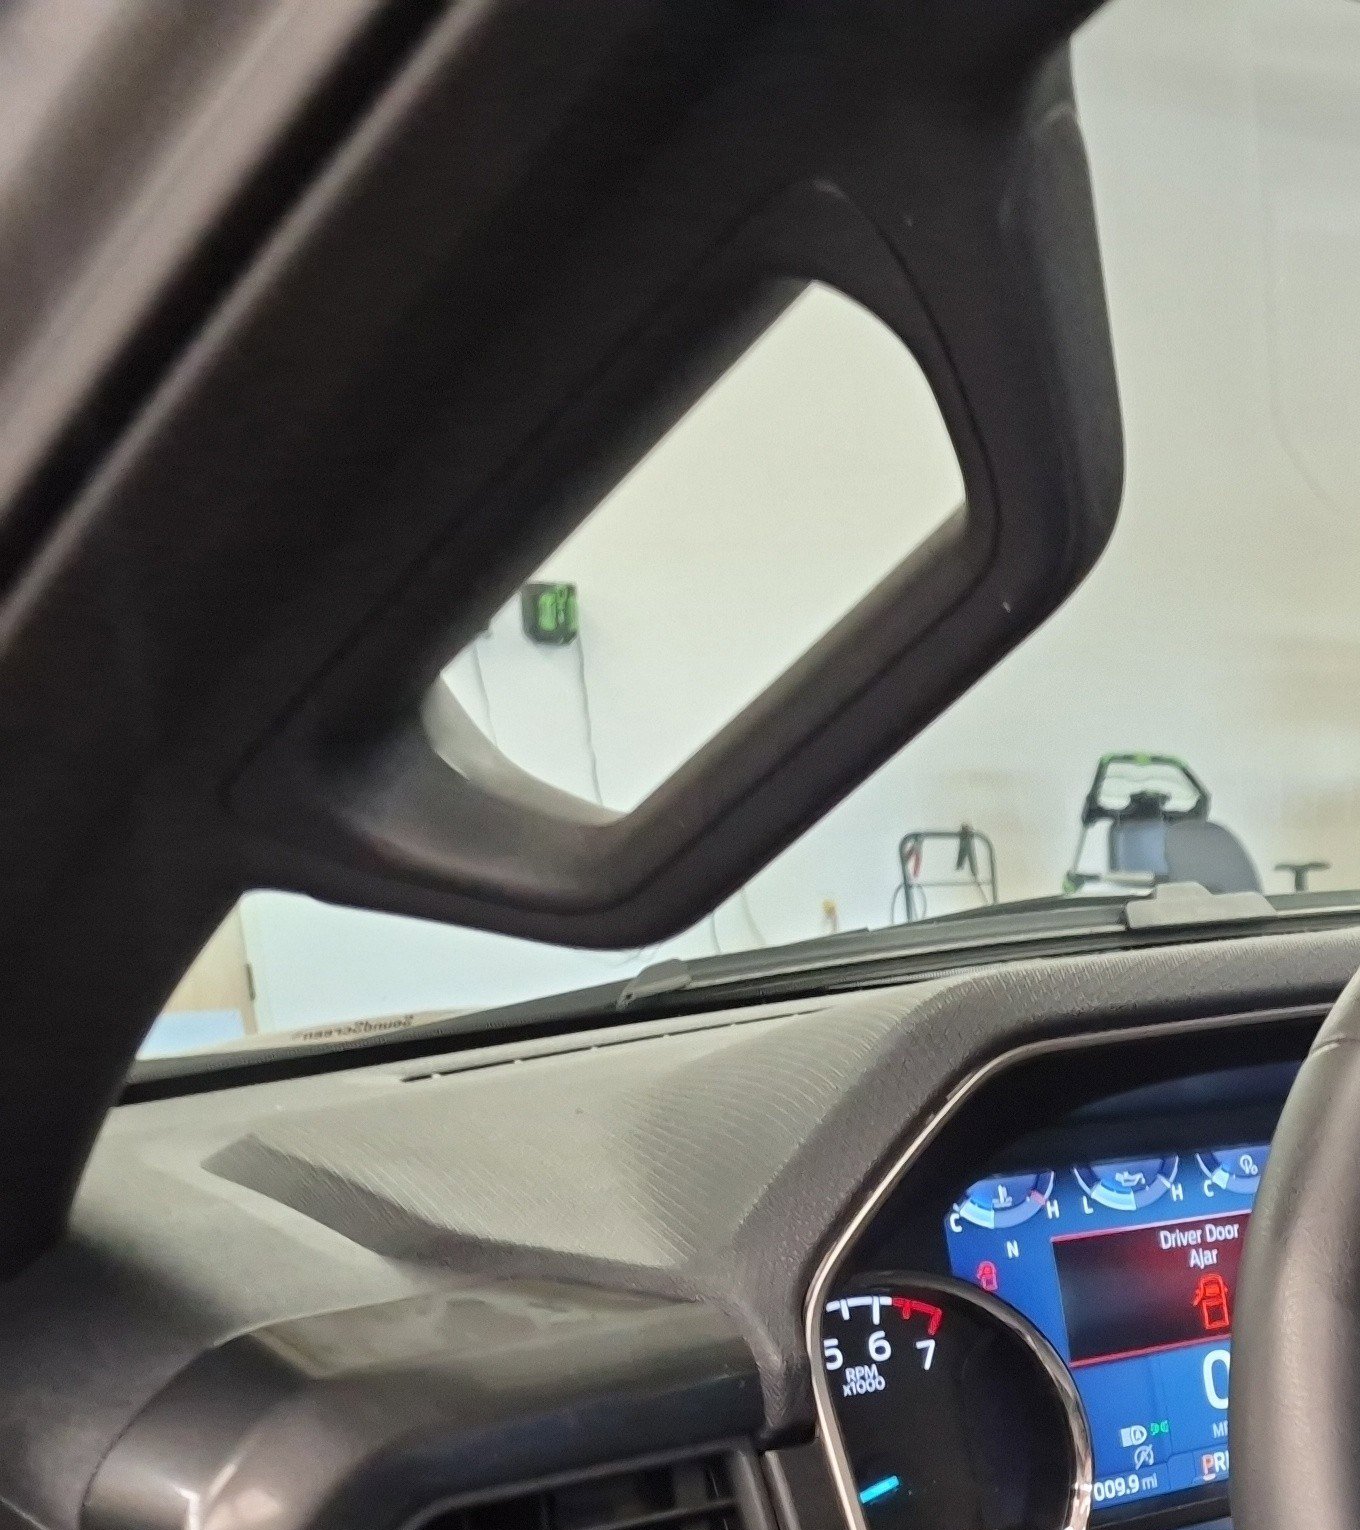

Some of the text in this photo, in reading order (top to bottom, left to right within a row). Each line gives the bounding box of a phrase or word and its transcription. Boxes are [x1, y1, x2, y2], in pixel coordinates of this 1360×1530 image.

[1082, 1182, 1184, 1214] L H
[1203, 1179, 1215, 1198] C
[950, 1199, 1060, 1233] C H
[1159, 1222, 1239, 1250] Driver Door
[1007, 1240, 1020, 1259] N
[1188, 1247, 1219, 1269] Ajar
[823, 1338, 844, 1371] 5
[868, 1330, 892, 1362] 6
[915, 1338, 936, 1371] 7
[844, 1363, 879, 1383] RPM
[842, 1375, 886, 1398] x1000
[1141, 1472, 1158, 1491] mi
